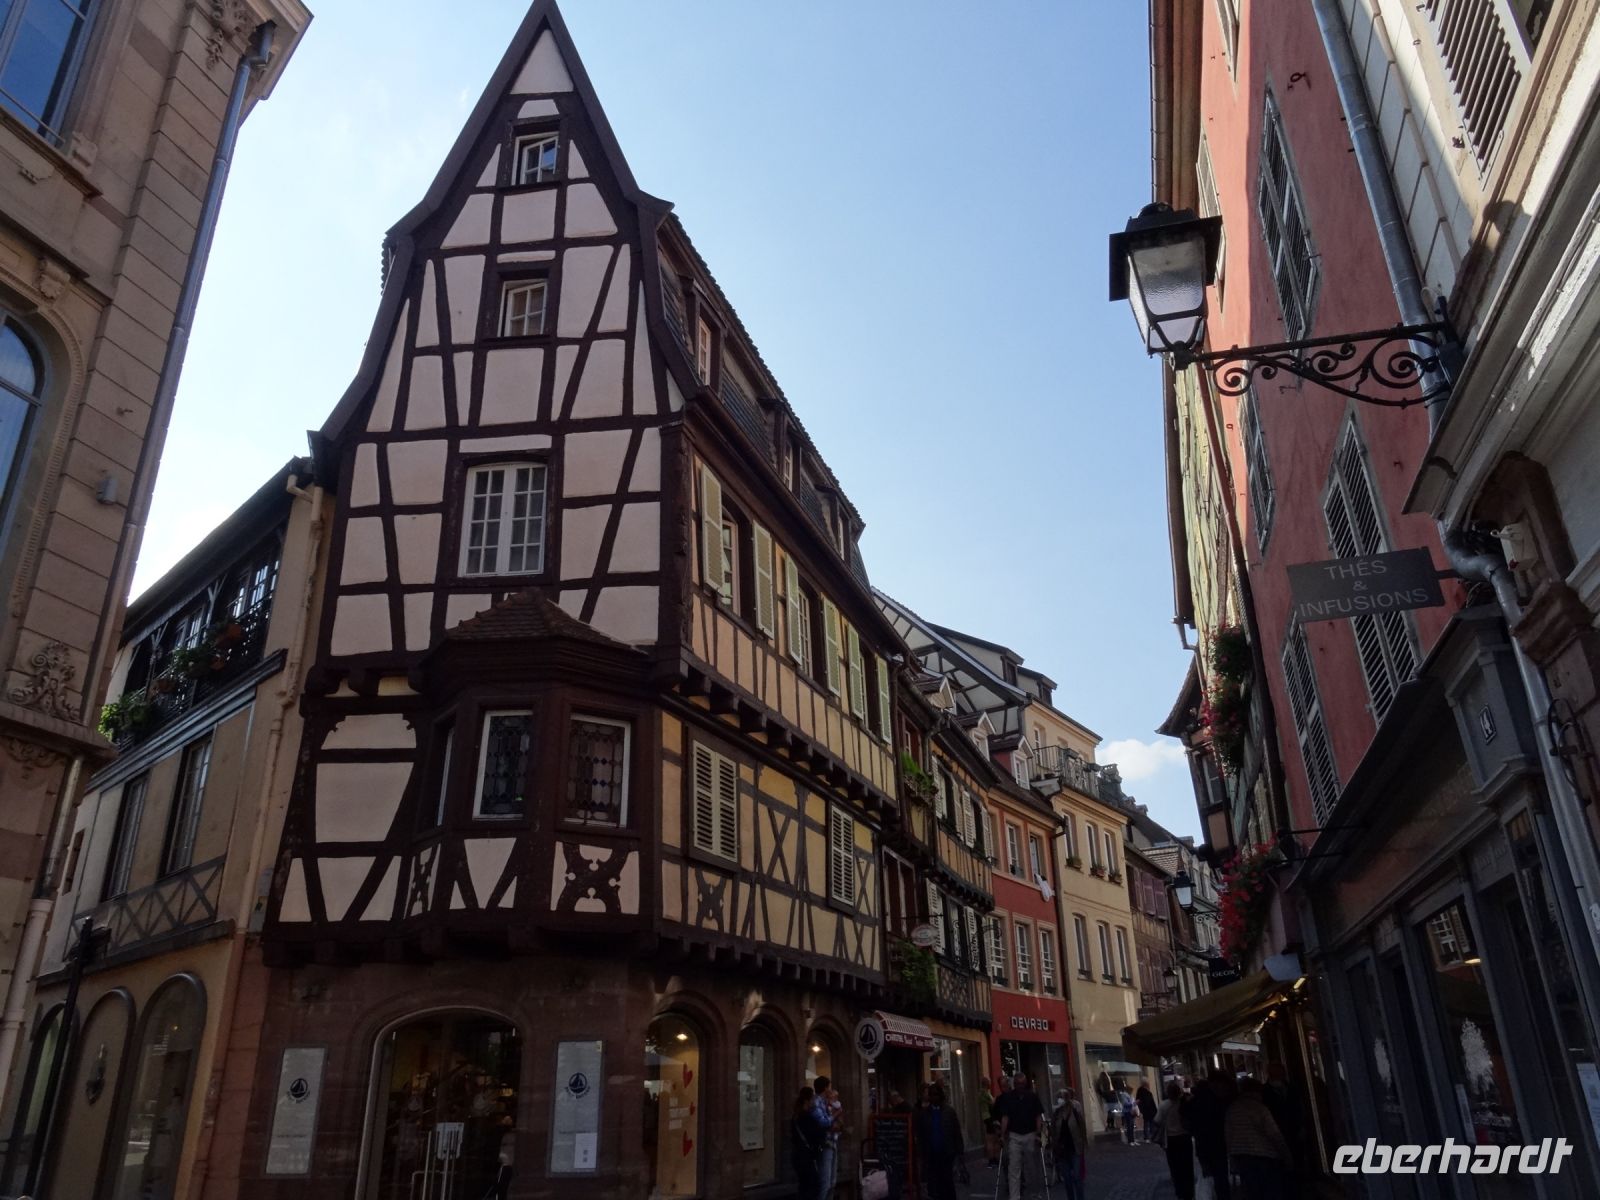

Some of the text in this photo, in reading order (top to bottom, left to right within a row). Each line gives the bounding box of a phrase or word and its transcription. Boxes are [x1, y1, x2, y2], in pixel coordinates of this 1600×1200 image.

[1323, 559, 1388, 580] THÉS
[1352, 580, 1369, 592] &
[1299, 588, 1430, 617] INFUSIONS
